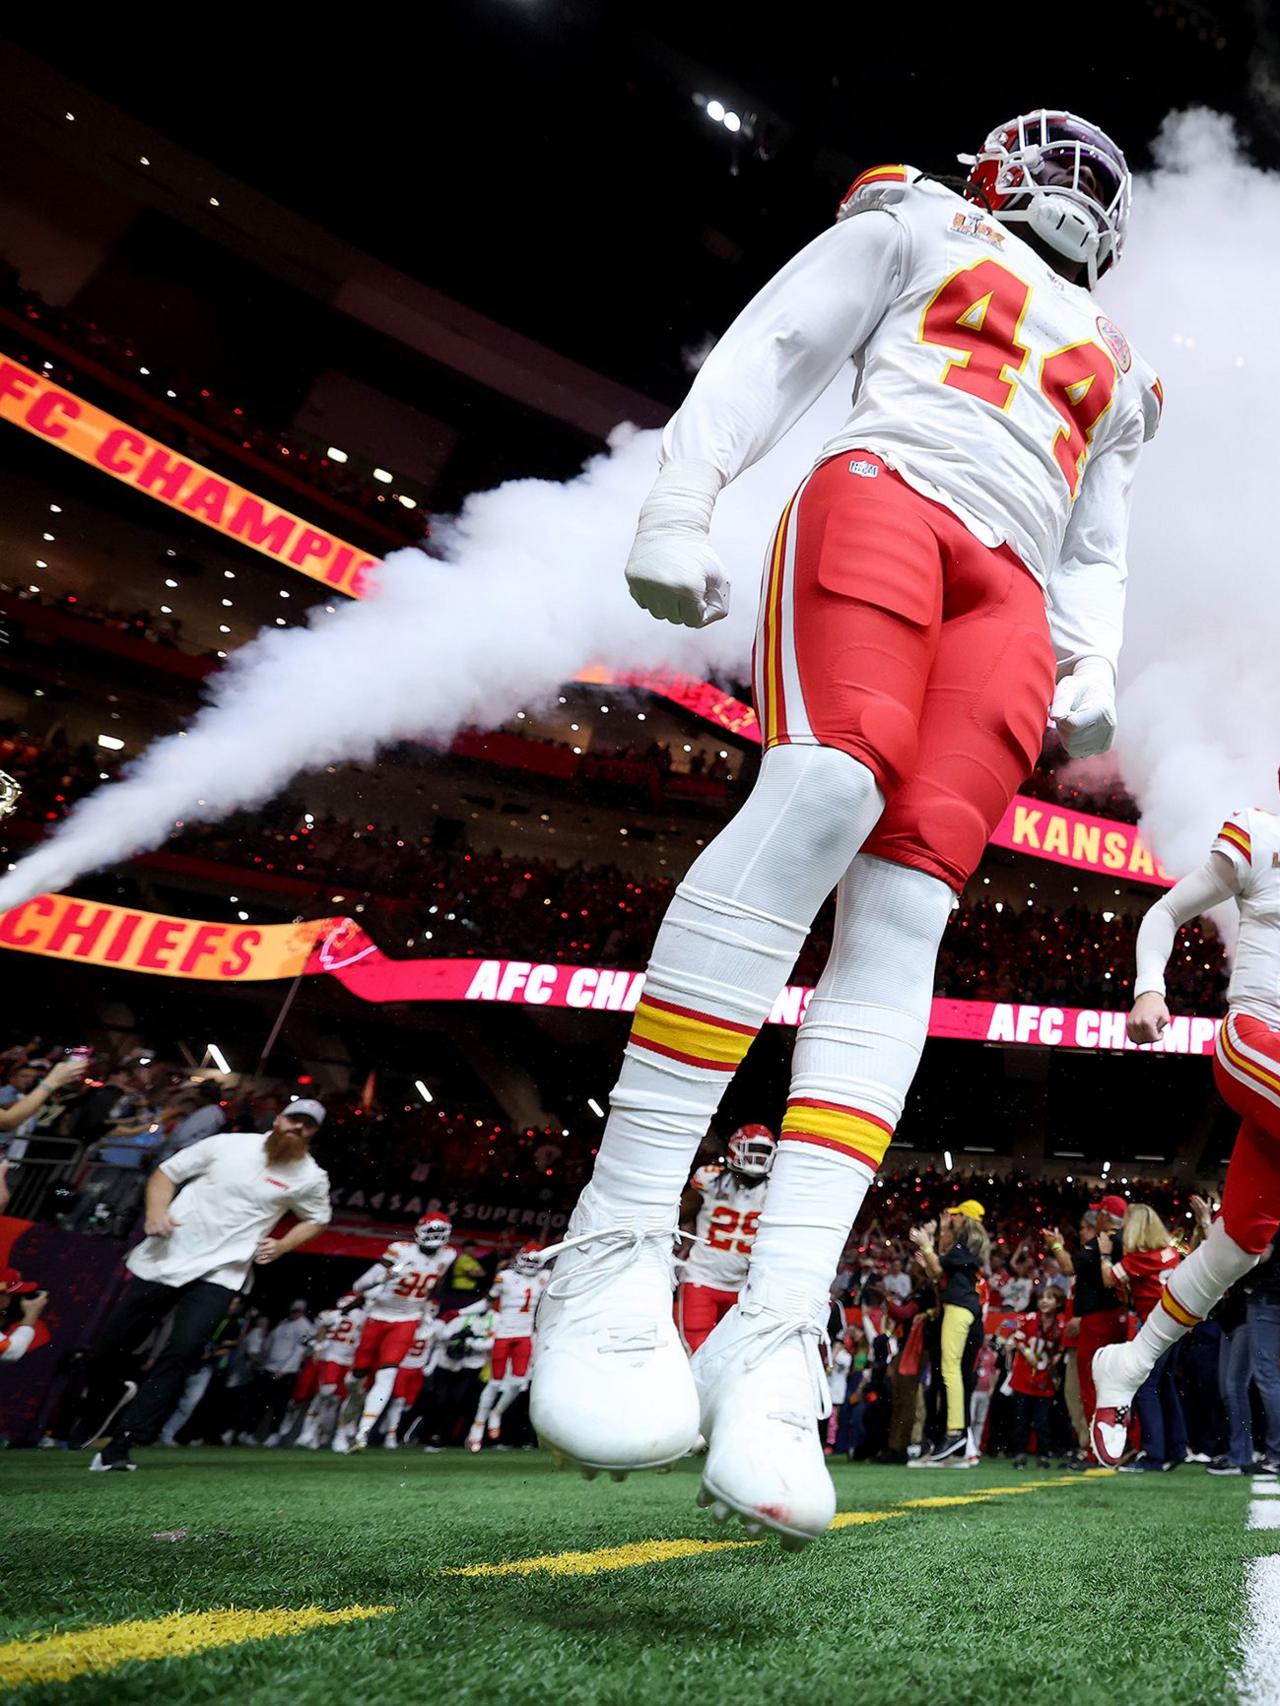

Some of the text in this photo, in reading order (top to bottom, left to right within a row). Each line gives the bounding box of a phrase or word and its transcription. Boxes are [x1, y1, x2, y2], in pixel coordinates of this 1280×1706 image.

[0, 895, 261, 977] CHIEFS
[466, 960, 559, 1004] AFC
[986, 1003, 1064, 1046] AFC
